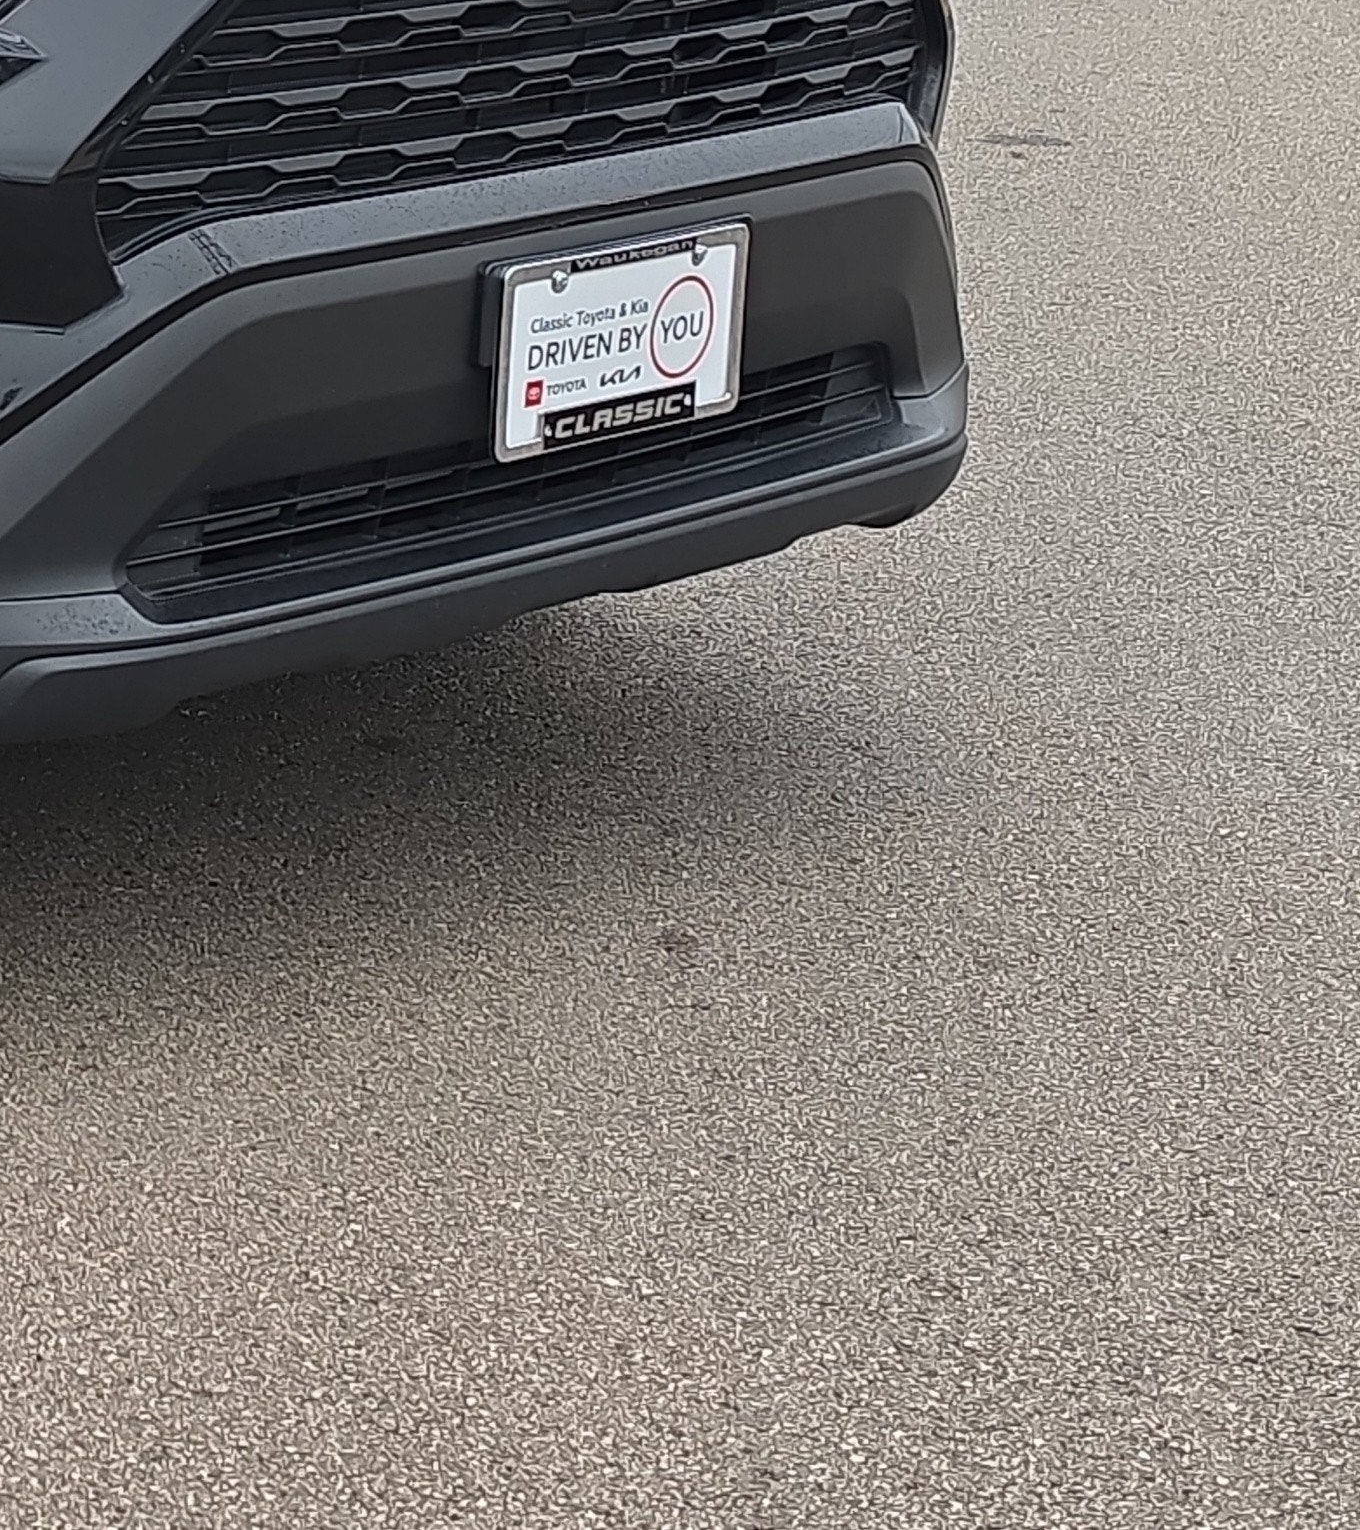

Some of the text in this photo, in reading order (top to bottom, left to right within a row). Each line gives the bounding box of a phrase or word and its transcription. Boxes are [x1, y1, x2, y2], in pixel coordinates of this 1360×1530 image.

[576, 240, 693, 269] Waukegan
[531, 298, 650, 333] Classic Toyota & Kia
[528, 311, 705, 371] DRIVEN BY YOU
[546, 379, 587, 396] TOYOTA
[554, 393, 684, 438] CLASSIC
